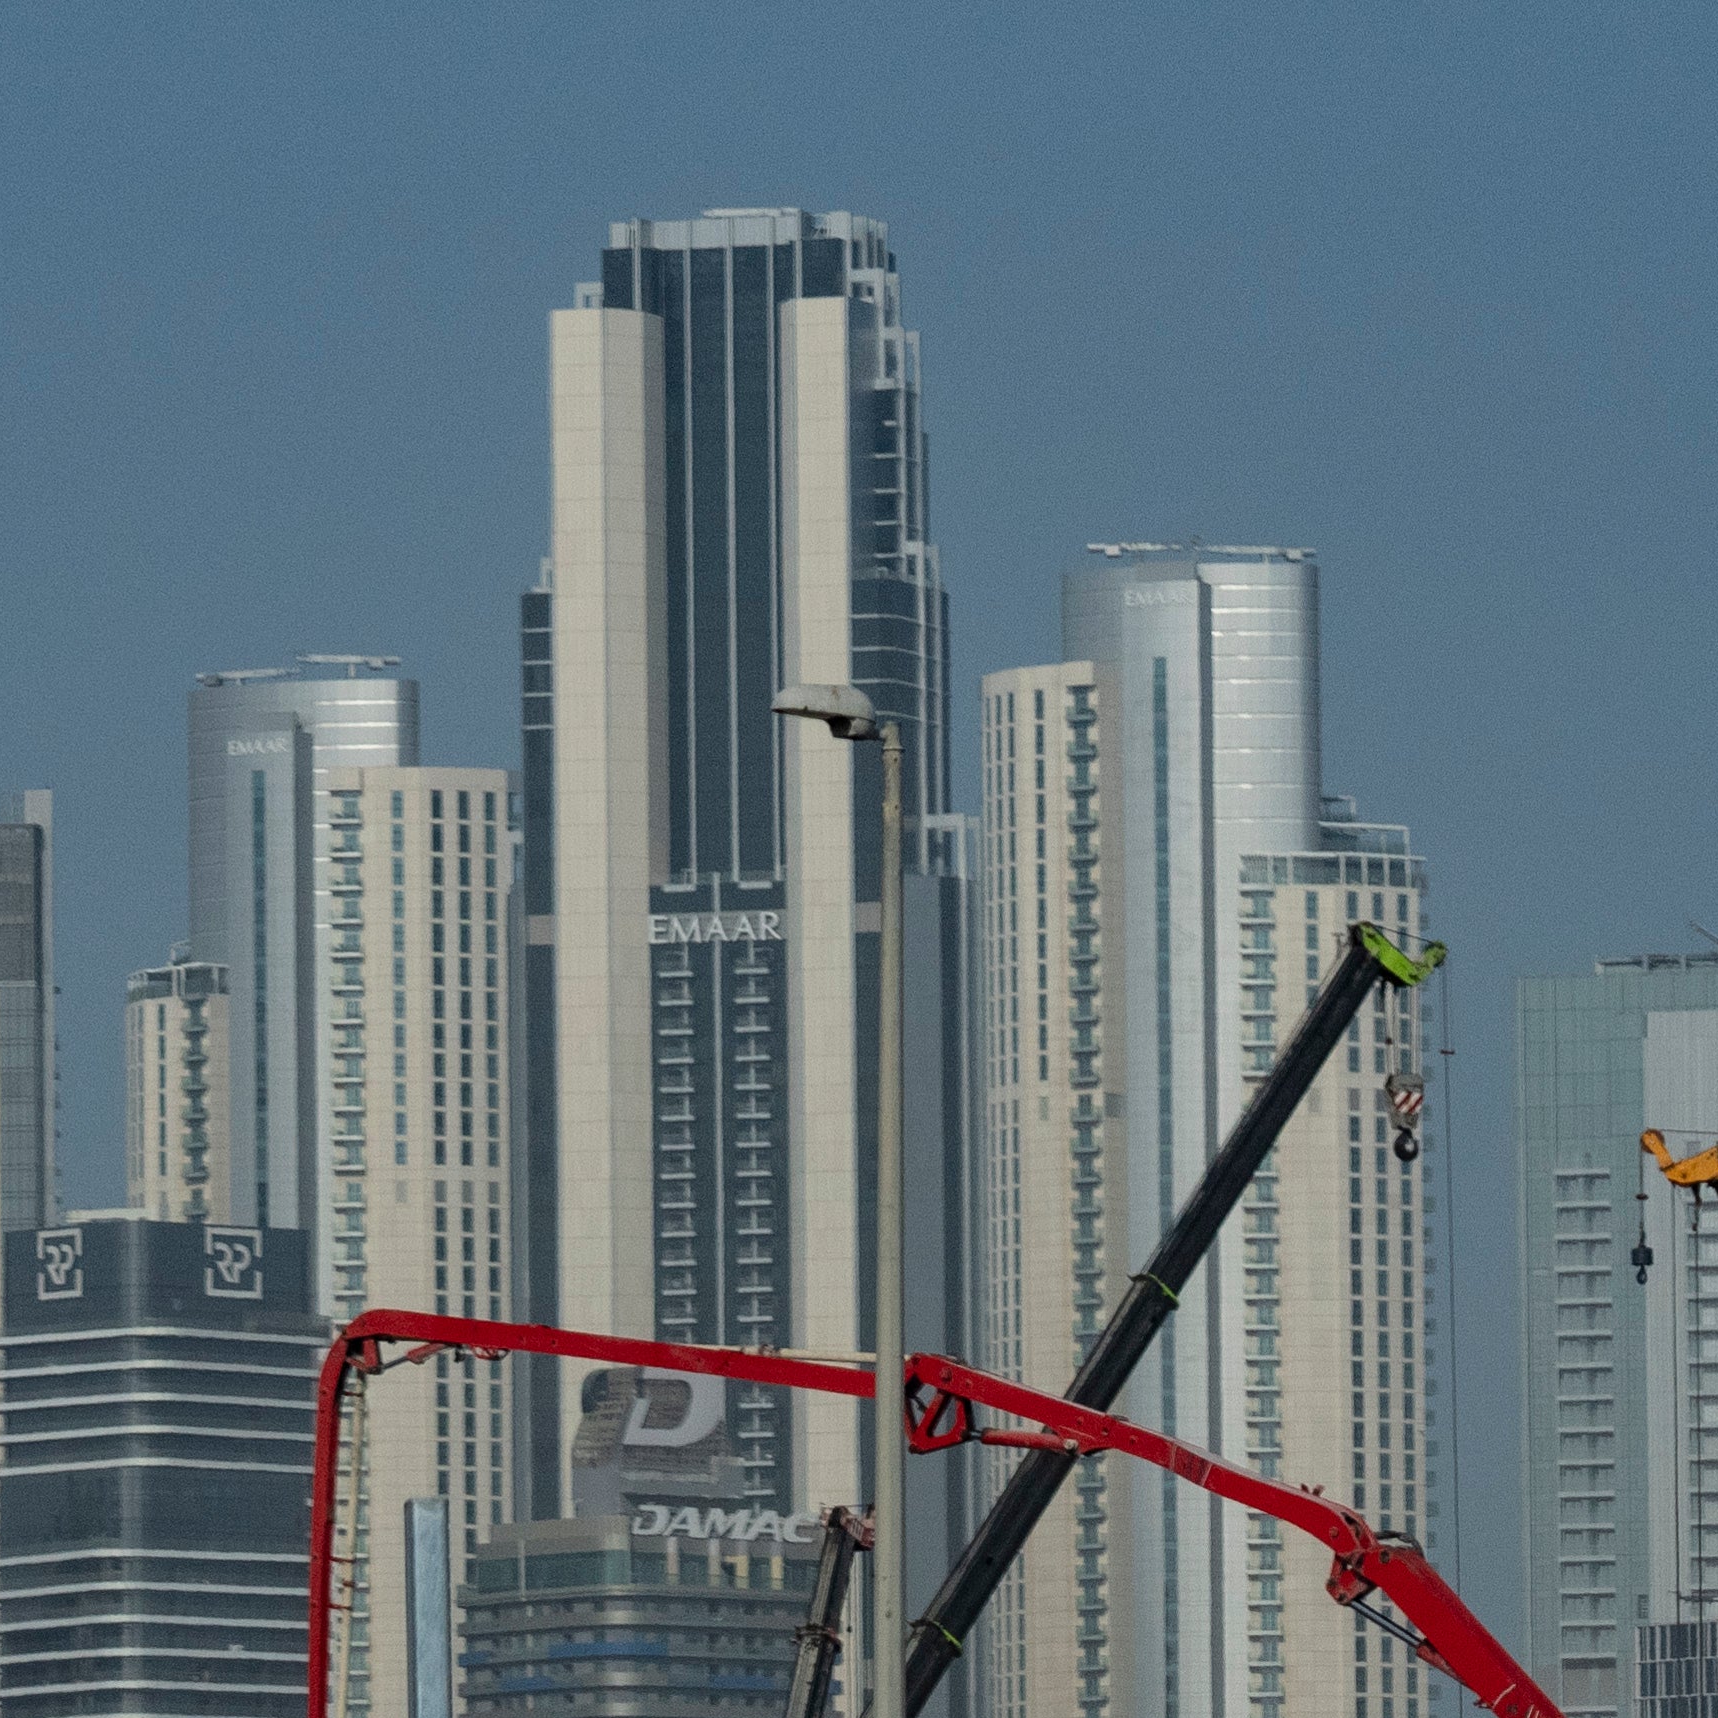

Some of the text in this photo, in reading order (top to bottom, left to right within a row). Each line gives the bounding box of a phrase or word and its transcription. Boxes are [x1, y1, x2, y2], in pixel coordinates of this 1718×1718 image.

[227, 738, 286, 755] EMAAR
[647, 911, 782, 943] EMAAR
[630, 1503, 818, 1544] DAMAC
